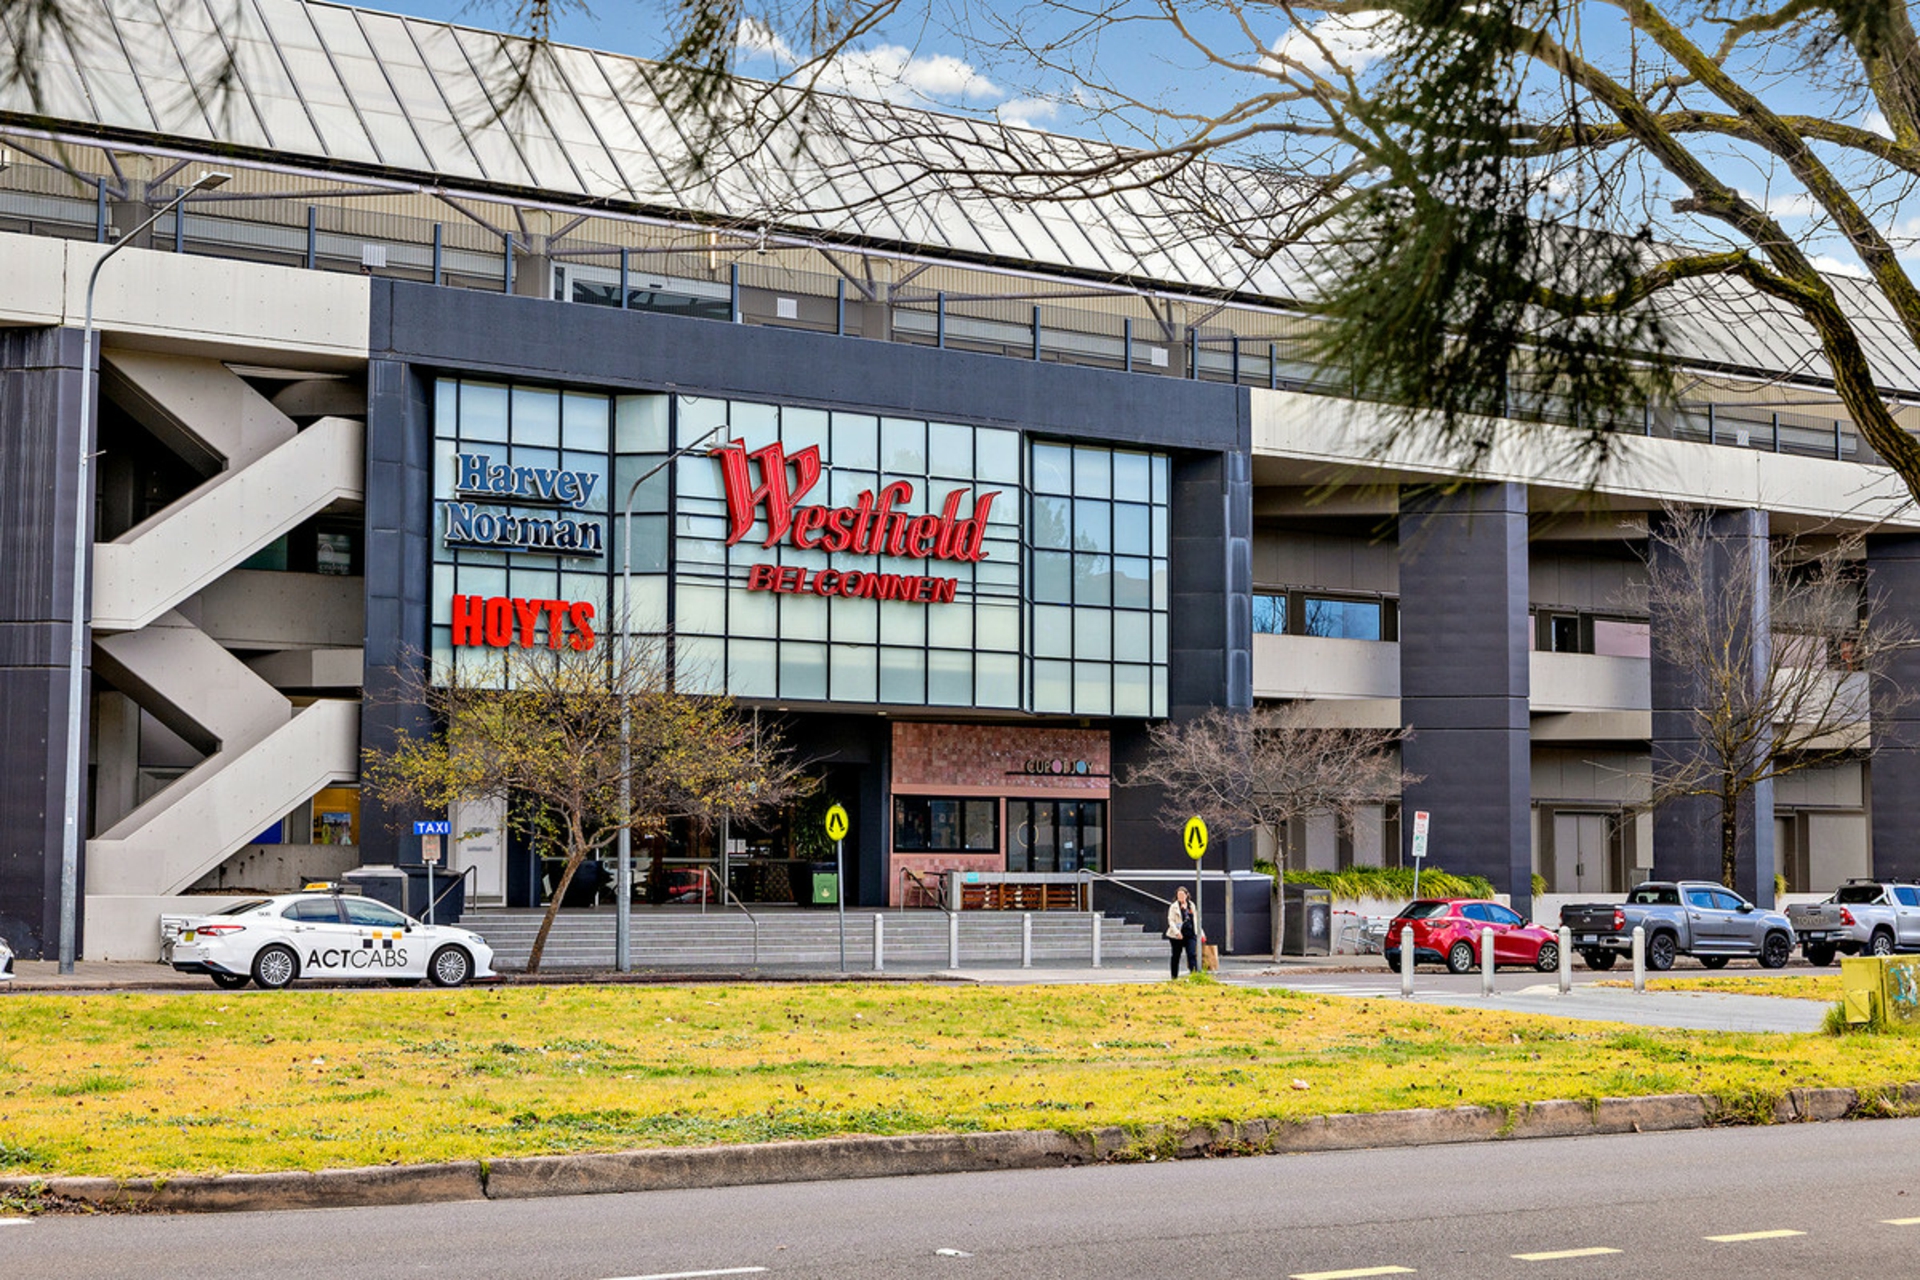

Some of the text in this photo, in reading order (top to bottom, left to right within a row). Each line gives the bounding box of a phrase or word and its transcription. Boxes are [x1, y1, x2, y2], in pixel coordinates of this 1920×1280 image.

[455, 453, 600, 508] Harvey
[707, 437, 1003, 563] Westfield
[445, 501, 603, 550] Norman
[747, 563, 958, 604] BELCONNEN
[452, 593, 596, 651] HOYTS
[1026, 759, 1051, 773] CUP
[1071, 760, 1094, 774] JOY
[417, 822, 449, 833] TAXI
[1796, 916, 1831, 925] TOYOTA
[306, 949, 408, 969] ACTCABS
